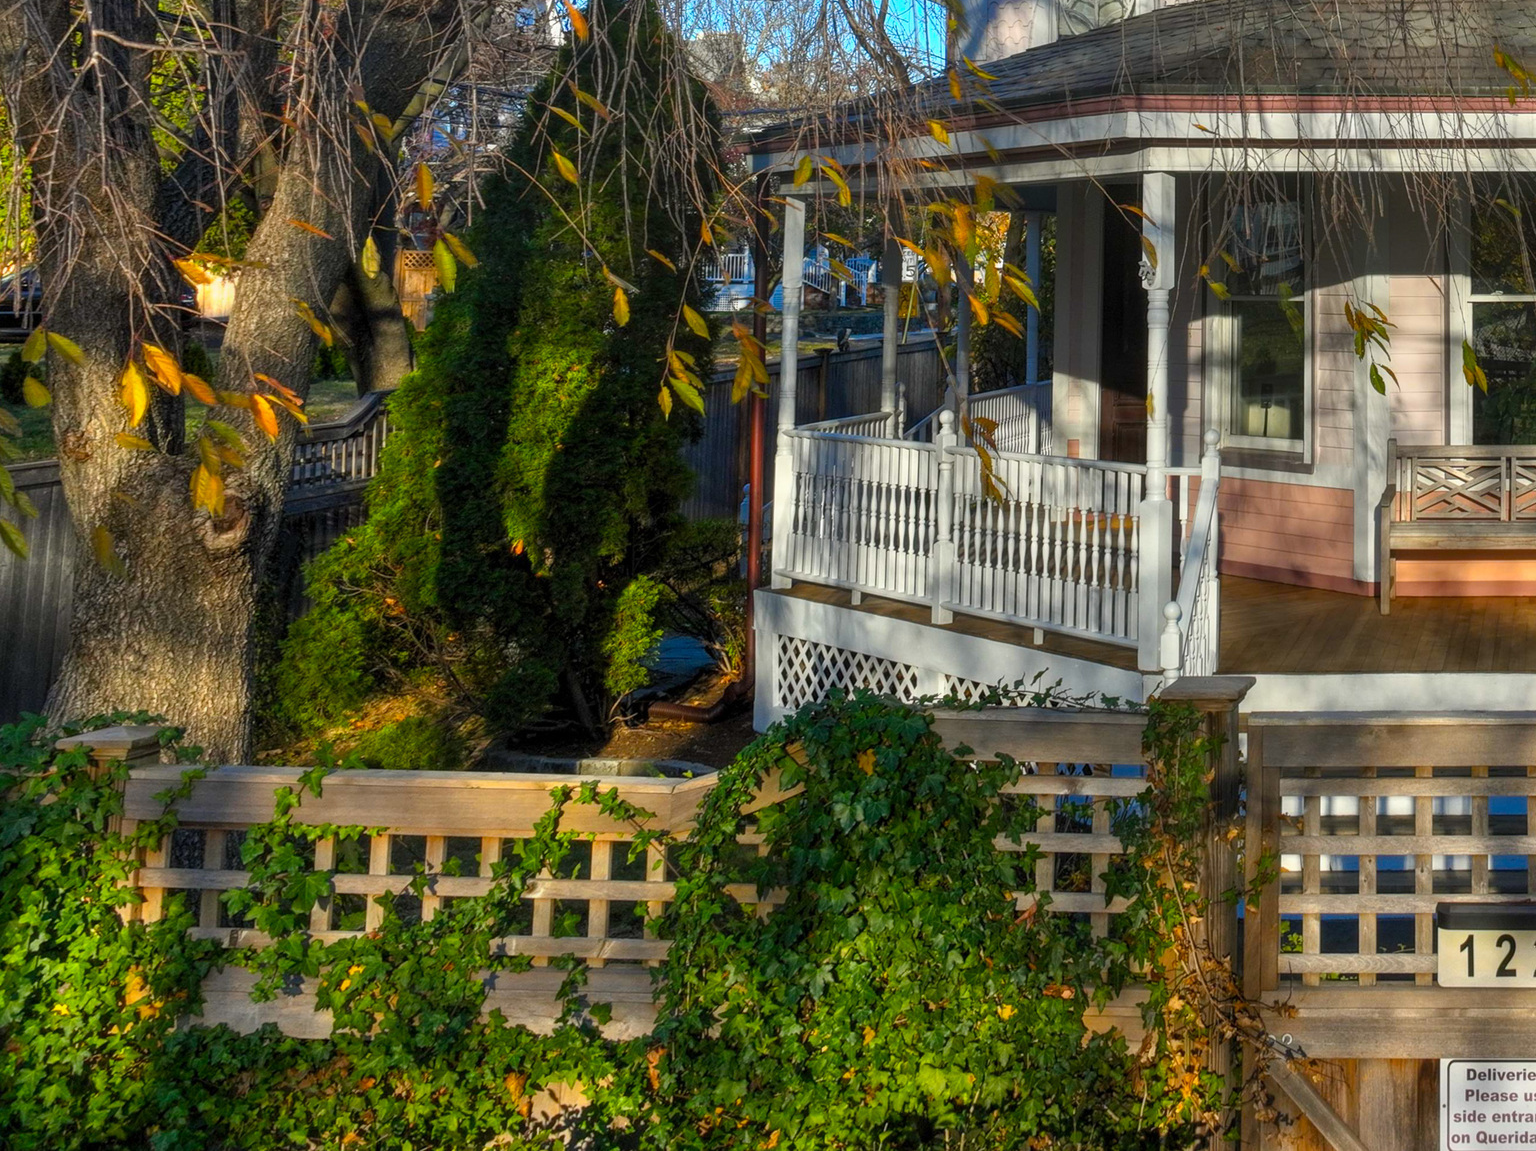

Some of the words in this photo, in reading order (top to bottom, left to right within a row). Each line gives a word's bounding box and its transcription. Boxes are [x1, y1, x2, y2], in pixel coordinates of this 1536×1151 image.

[1465, 1089, 1519, 1102] Please
[1453, 1110, 1487, 1123] side
[1451, 1133, 1471, 1144] on
